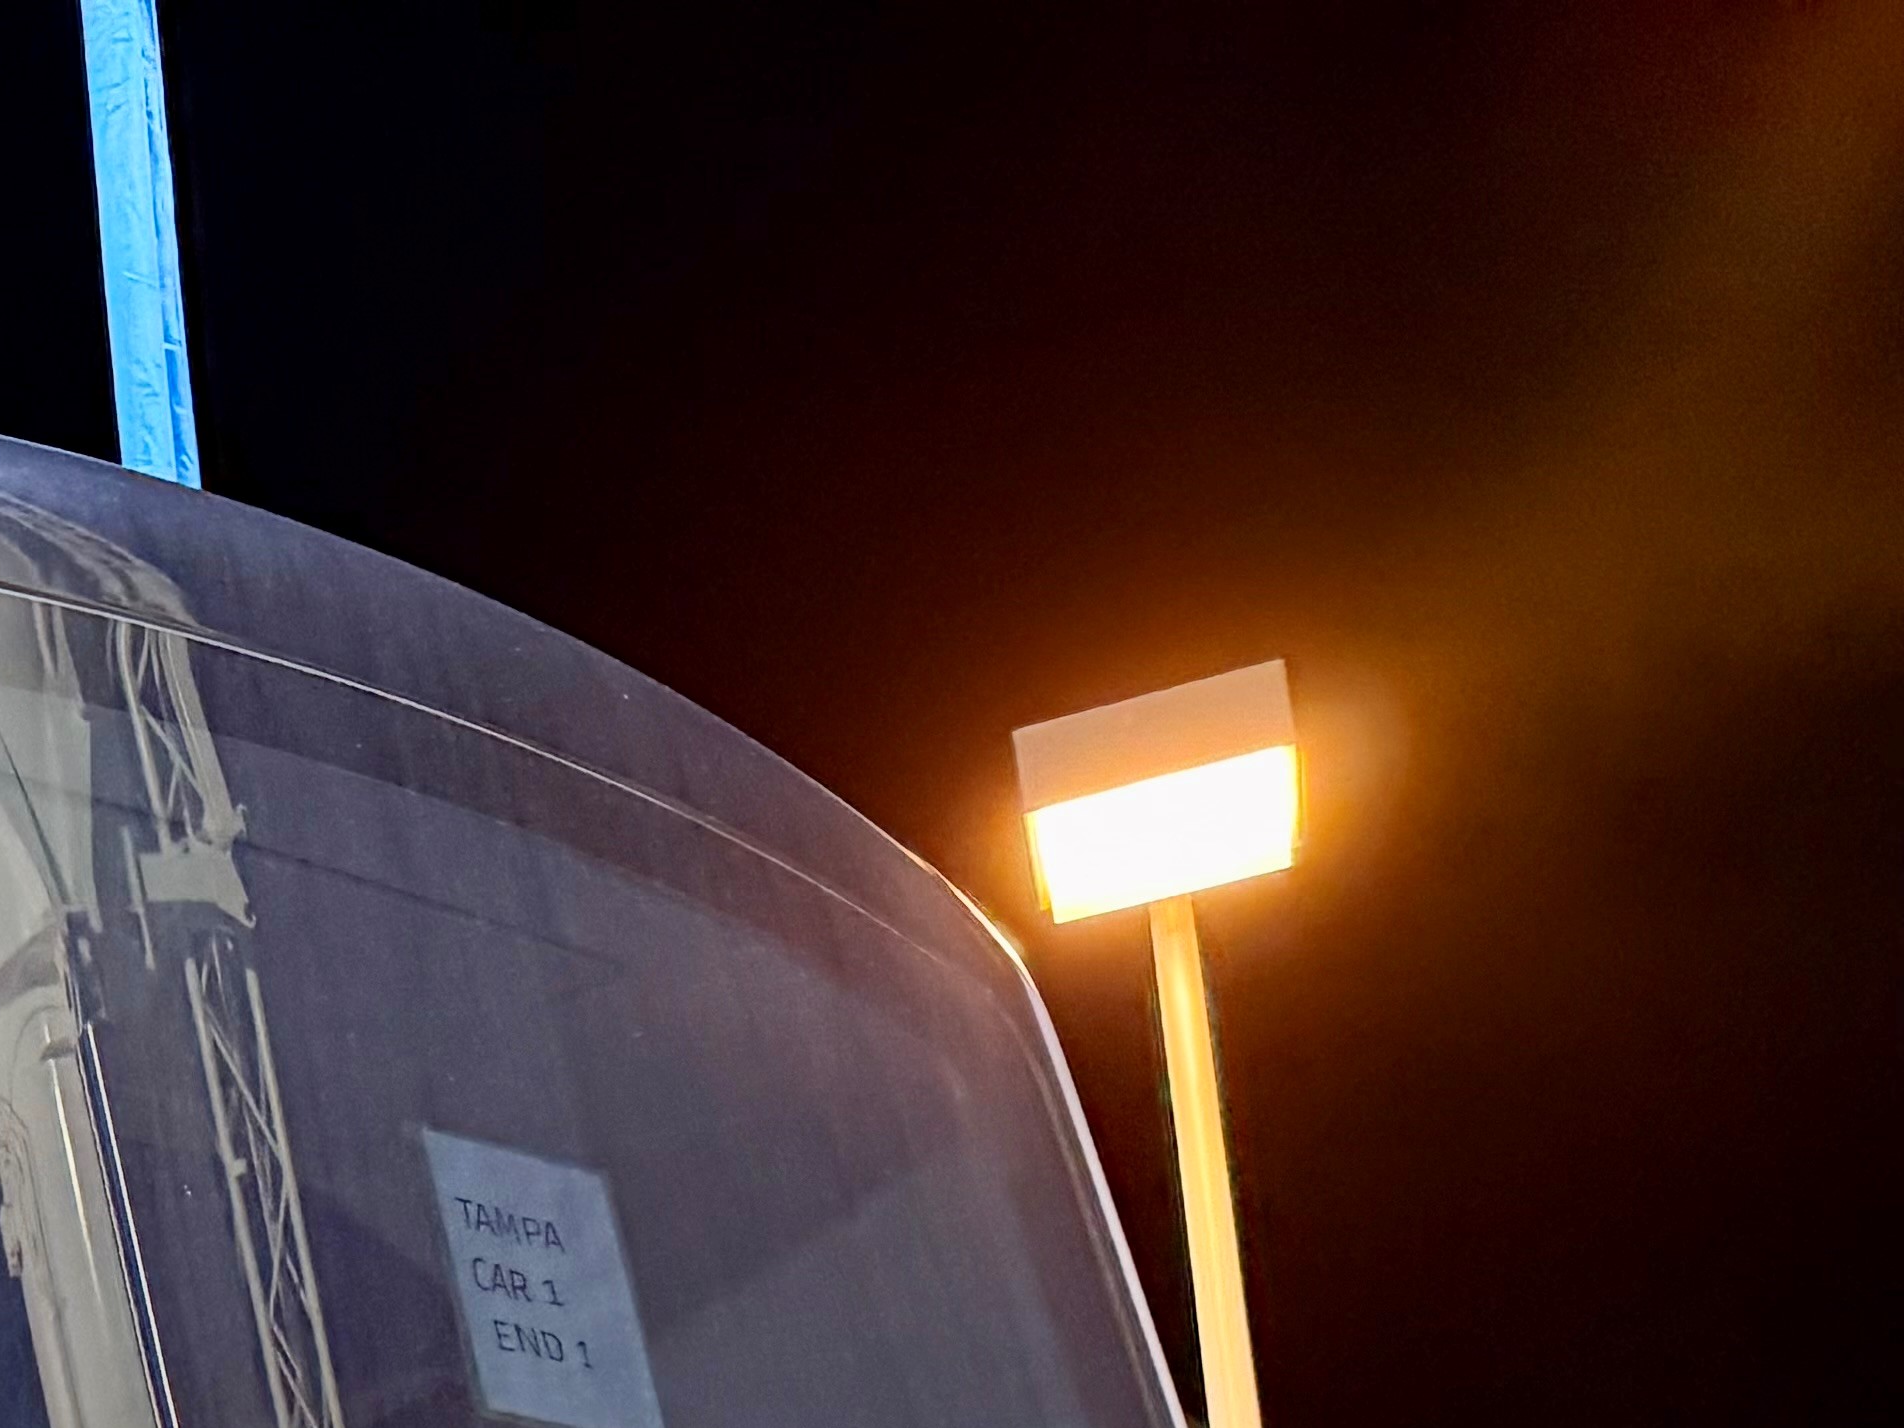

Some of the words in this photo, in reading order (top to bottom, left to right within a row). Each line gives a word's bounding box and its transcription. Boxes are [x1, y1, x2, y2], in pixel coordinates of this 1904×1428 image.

[454, 1196, 566, 1253] TAMPA
[472, 1256, 533, 1304] CAR
[541, 1278, 566, 1307] 1
[493, 1319, 565, 1363] END
[576, 1340, 594, 1369] 1
